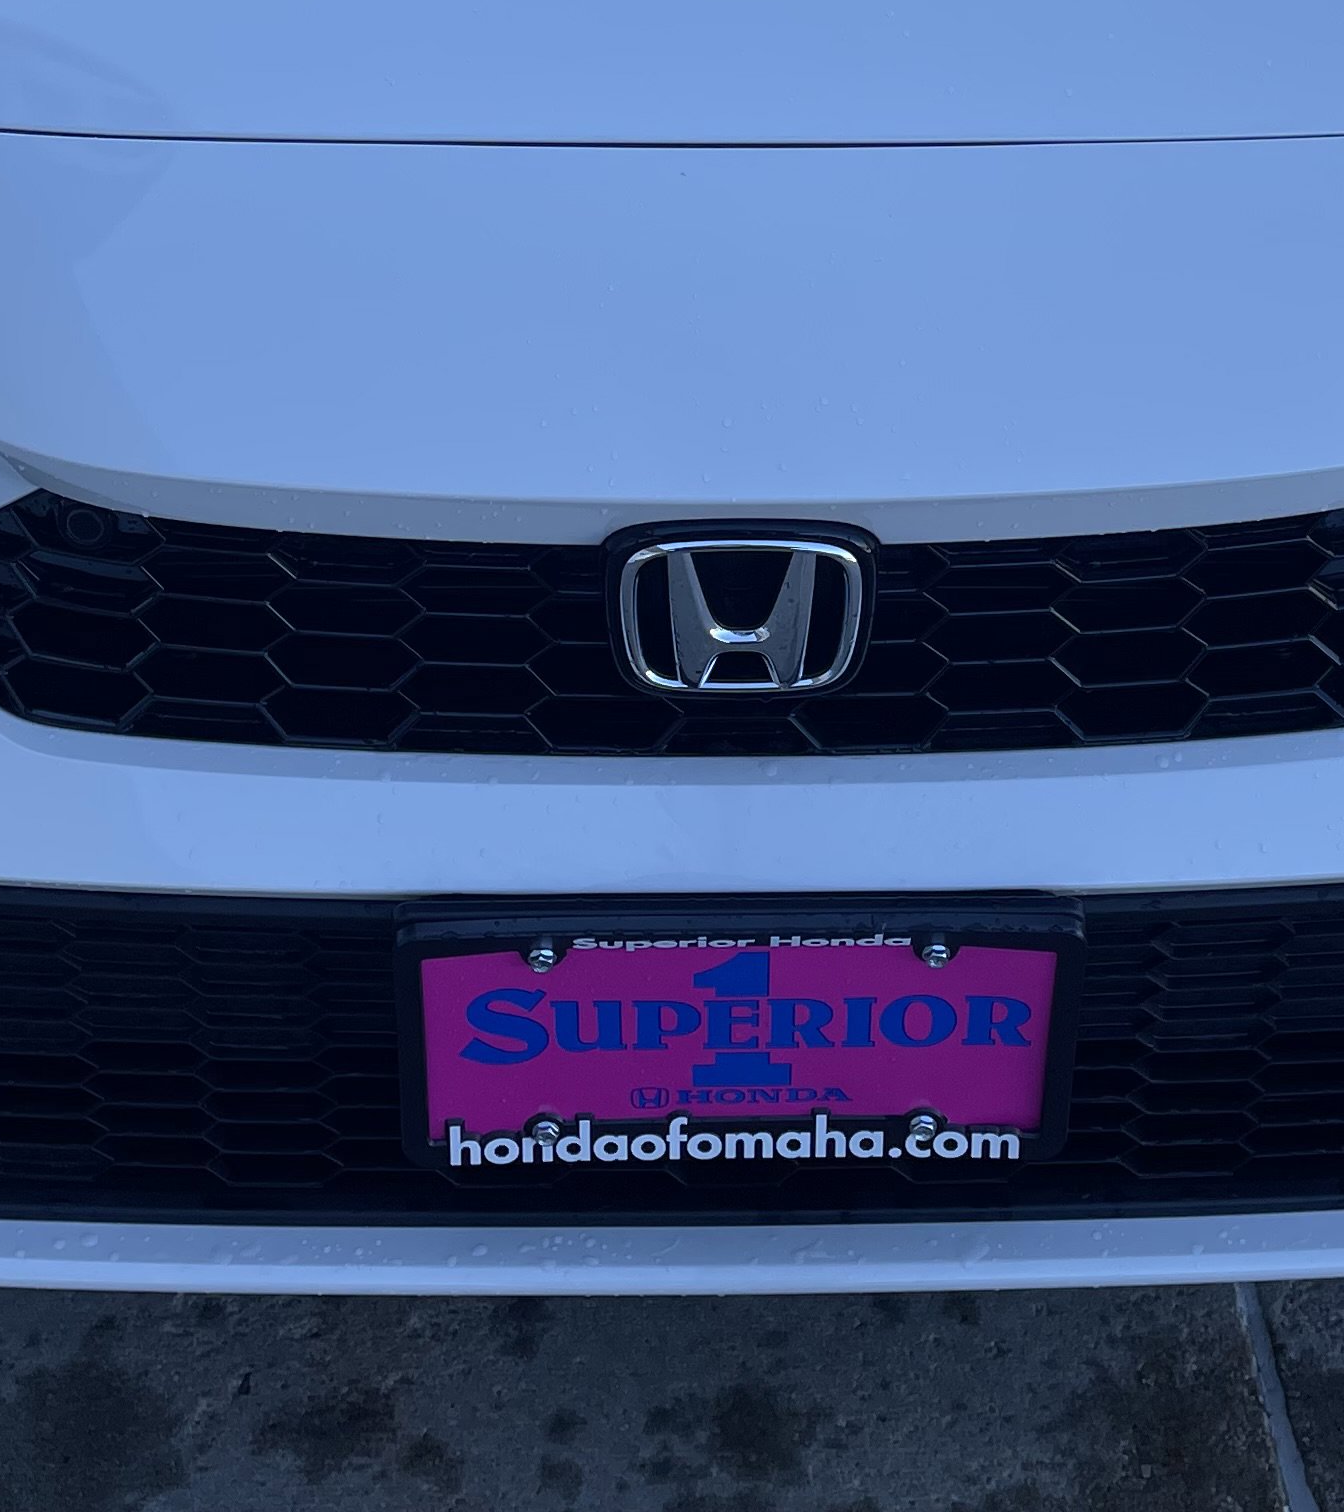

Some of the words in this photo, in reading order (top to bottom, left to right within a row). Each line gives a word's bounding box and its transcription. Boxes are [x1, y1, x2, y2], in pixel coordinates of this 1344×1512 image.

[572, 937, 756, 951] Superior
[770, 934, 912, 947] Honda
[458, 988, 1032, 1065] SUPERIOR
[676, 1088, 853, 1105] HONDA
[449, 1115, 1020, 1167] hondaofomaha.com
